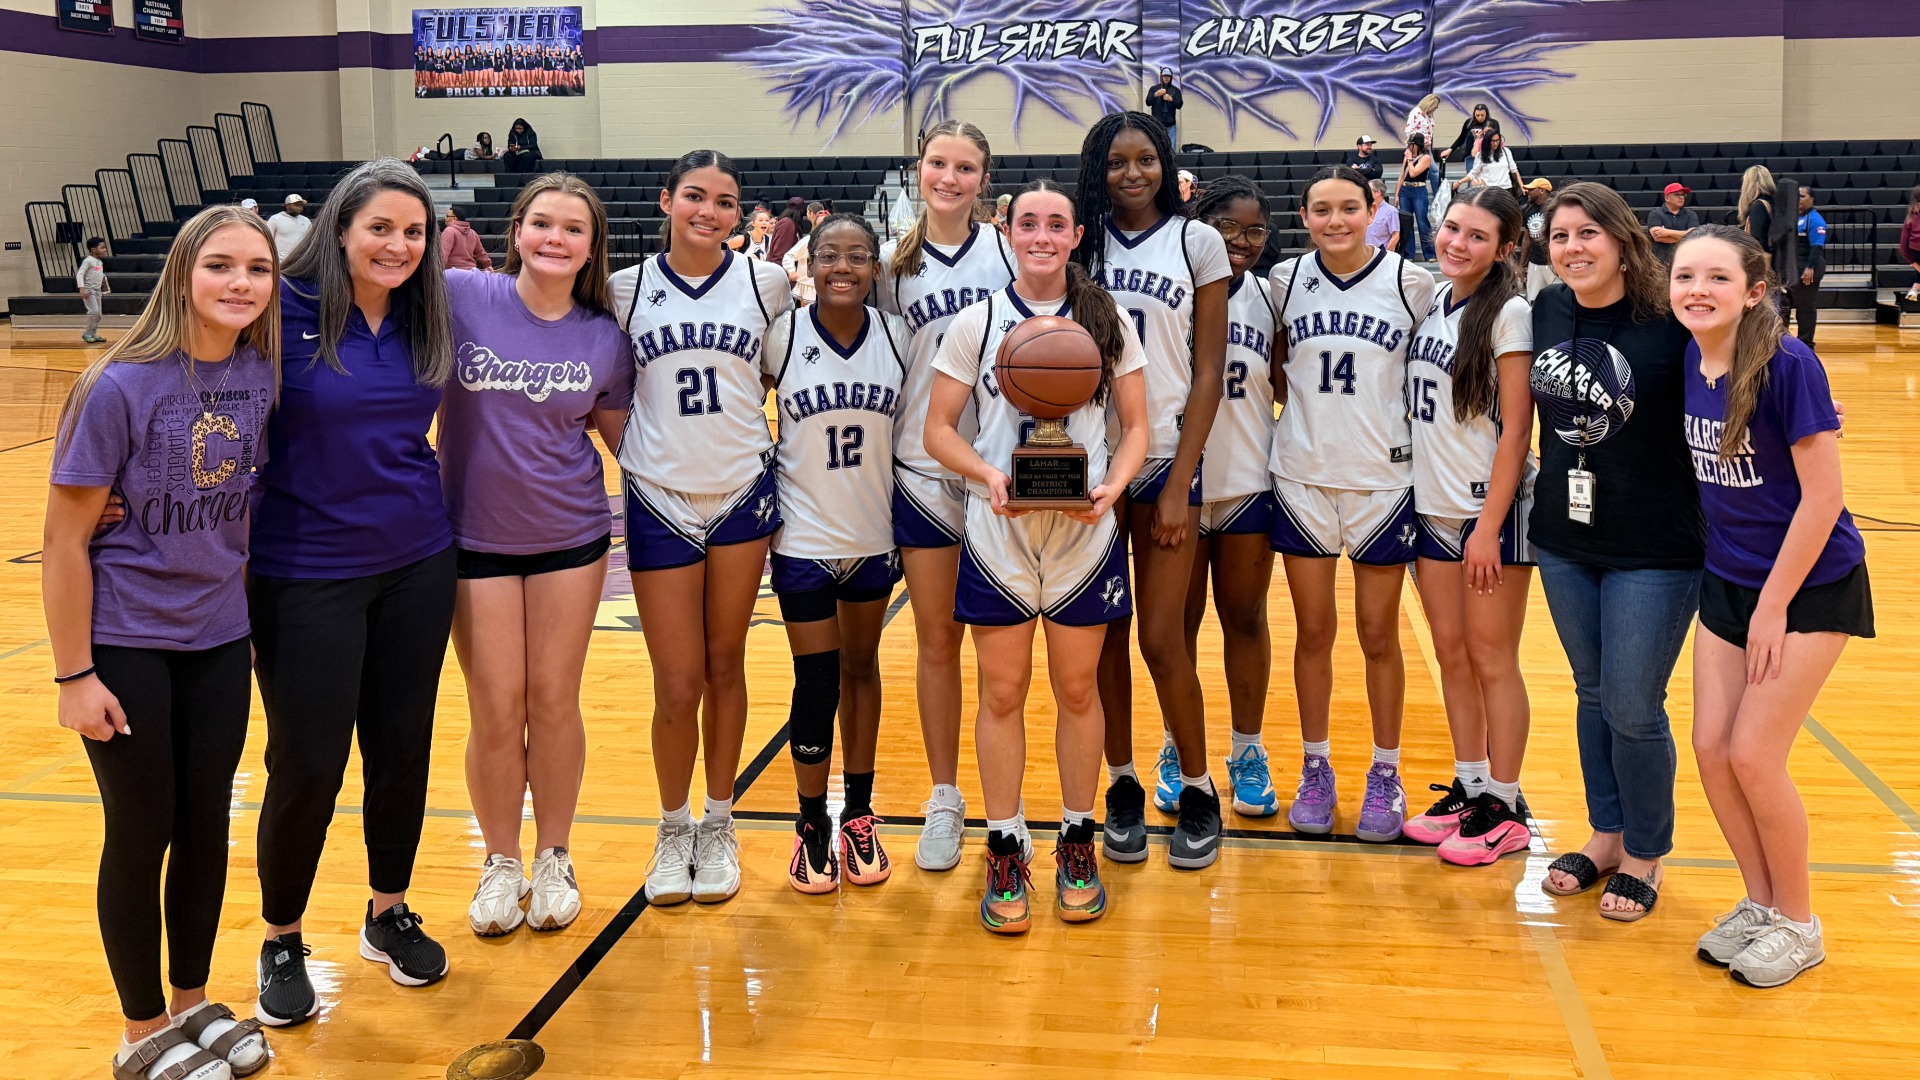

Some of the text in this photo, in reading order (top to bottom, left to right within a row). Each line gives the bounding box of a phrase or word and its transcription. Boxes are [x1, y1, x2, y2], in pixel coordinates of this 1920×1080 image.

[142, 7, 173, 17] CHAMPIONS
[145, 1, 171, 10] NATIONAL
[417, 13, 578, 42] FULSHEAR
[914, 19, 1137, 65] FULSHEAR
[1185, 10, 1426, 58] CHARGERS
[446, 86, 550, 97] BRICK BY BRICK
[903, 286, 998, 336] CHARGE
[1288, 310, 1403, 353] CHARGERS
[632, 321, 760, 369] CHARGERS
[458, 341, 593, 403] Chargers
[675, 365, 724, 417] 21
[1222, 360, 1249, 401] 2
[1318, 350, 1357, 396] 14
[1533, 348, 1614, 411] CHARGER
[1411, 375, 1438, 425] 15
[142, 418, 165, 497] Chargers
[166, 419, 187, 492] CHARGERS
[187, 412, 242, 492] C
[825, 424, 865, 471] 12
[1029, 459, 1059, 467] LAMAR
[1027, 488, 1073, 496] CHAMPIONS
[1031, 480, 1068, 488] DISTRICT
